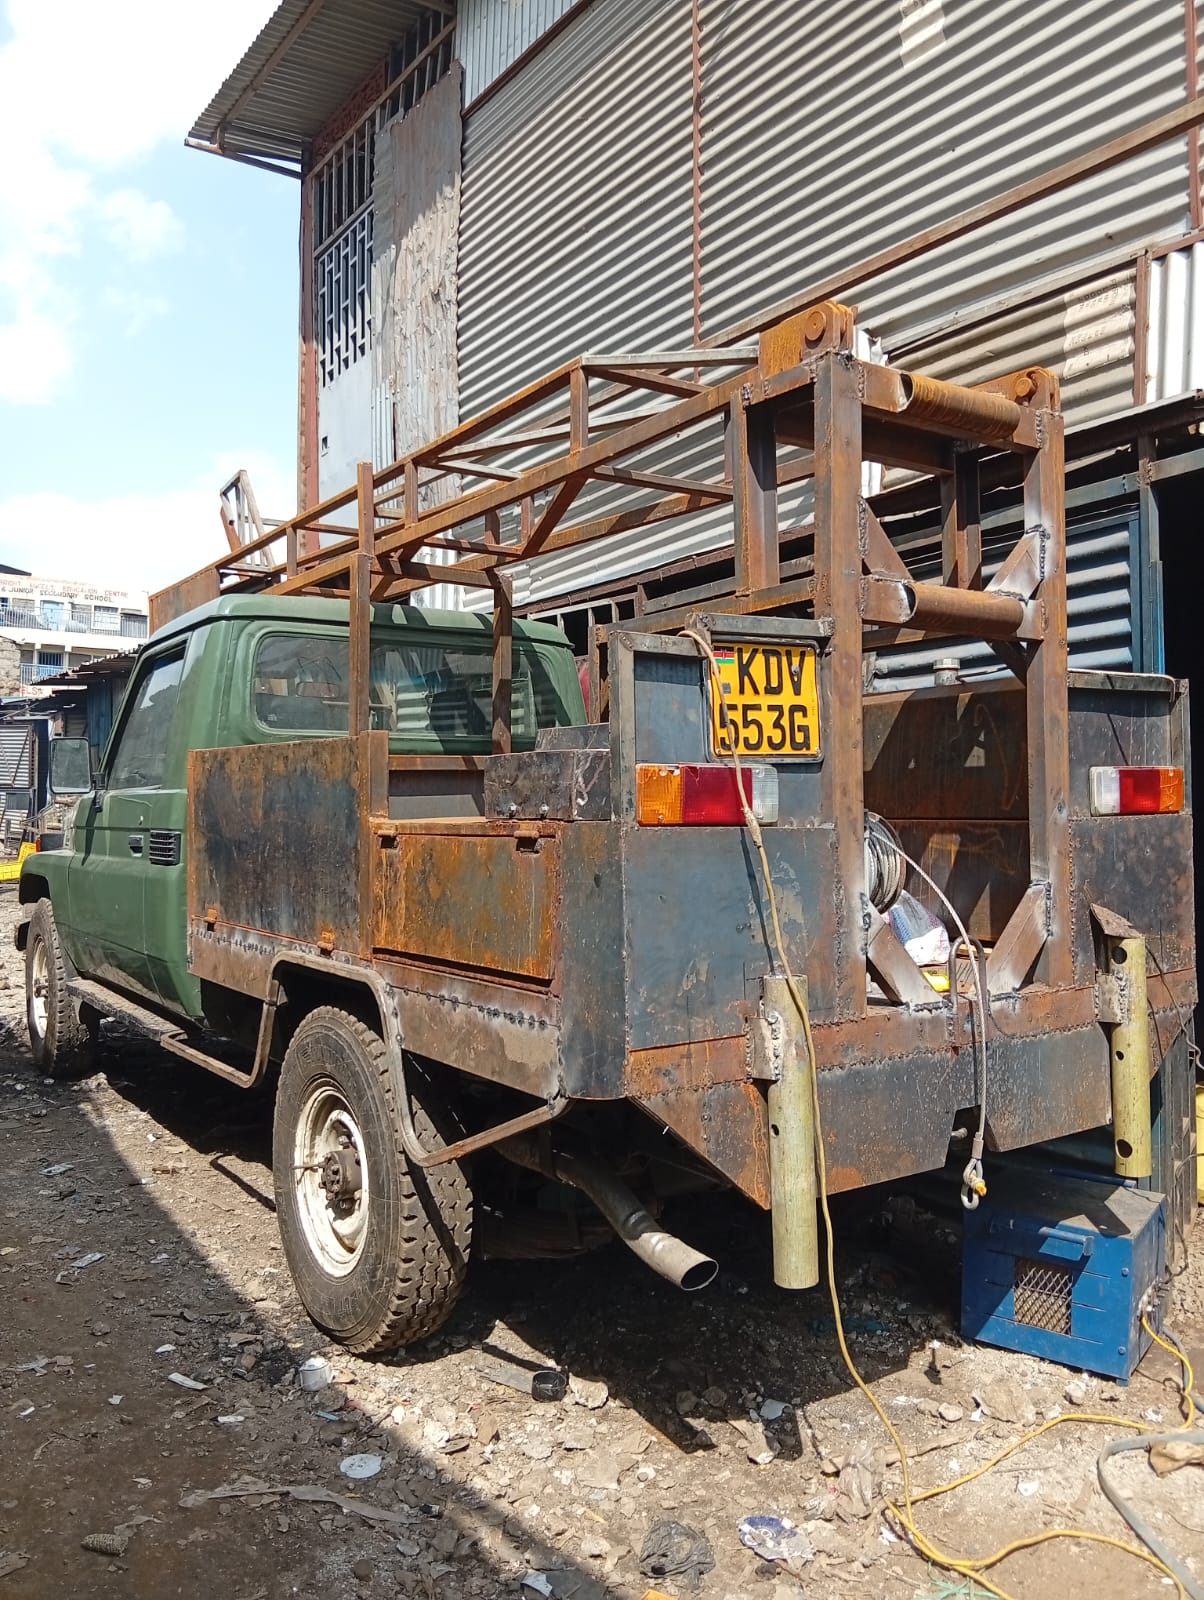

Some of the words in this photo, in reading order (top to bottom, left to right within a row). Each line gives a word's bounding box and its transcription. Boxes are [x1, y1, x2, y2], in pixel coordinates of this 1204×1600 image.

[8, 587, 34, 595] JUNIOR
[40, 590, 78, 599] SECONDARY
[84, 594, 112, 603] SCHOOL
[105, 590, 128, 599] CENTRE
[736, 646, 806, 696] KDV
[719, 703, 811, 751] 553G
